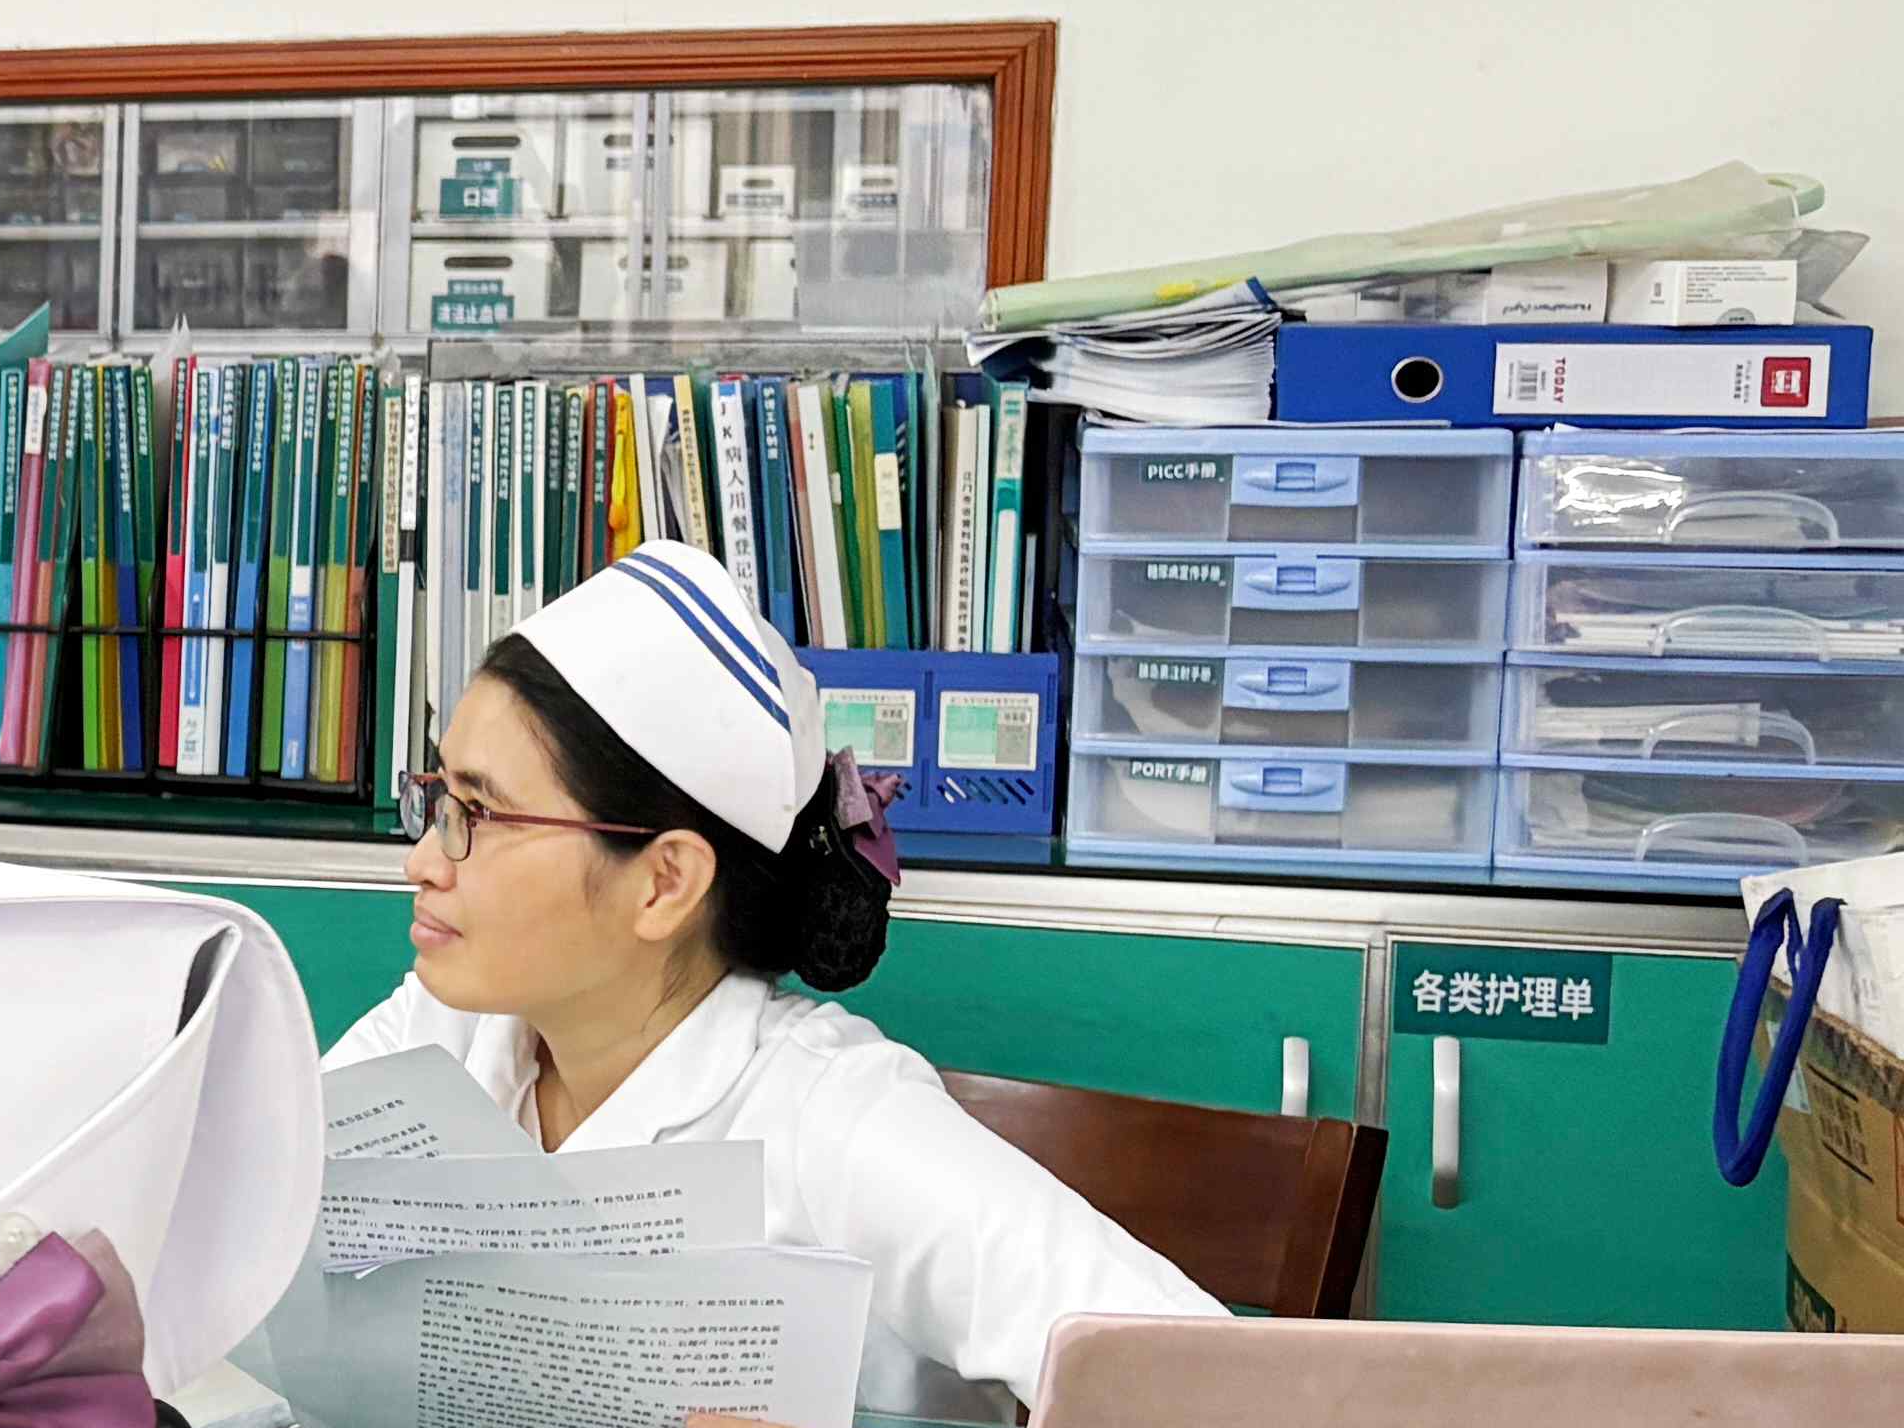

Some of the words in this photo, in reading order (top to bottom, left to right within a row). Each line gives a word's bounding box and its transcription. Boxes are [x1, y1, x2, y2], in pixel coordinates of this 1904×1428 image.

[1411, 969, 1595, 1021] 各类护理单
